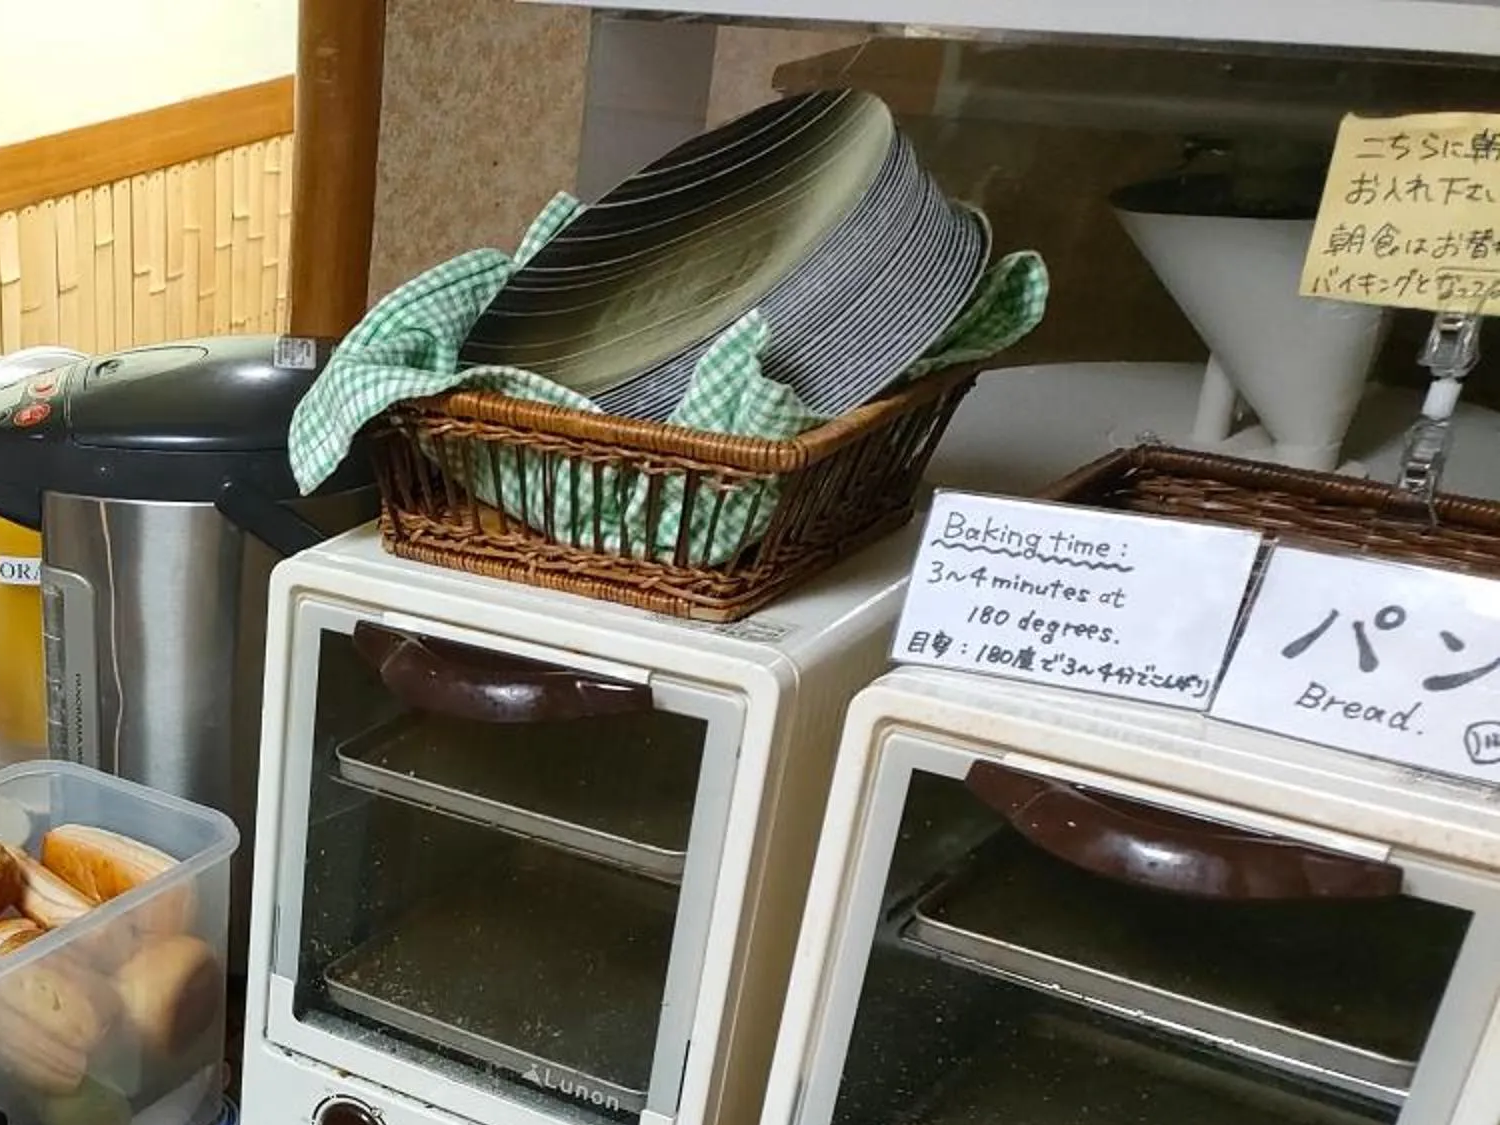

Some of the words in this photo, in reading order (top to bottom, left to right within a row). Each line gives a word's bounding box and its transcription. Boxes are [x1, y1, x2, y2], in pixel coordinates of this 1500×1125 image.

[943, 511, 1042, 560] Baking
[991, 574, 1091, 602] minutes
[1099, 587, 1127, 609] at
[967, 605, 1011, 627] 180
[1017, 609, 1120, 645] degrees.
[1281, 604, 1500, 692] パン
[1294, 680, 1425, 736] Bread.
[544, 1067, 620, 1112] Lunon
